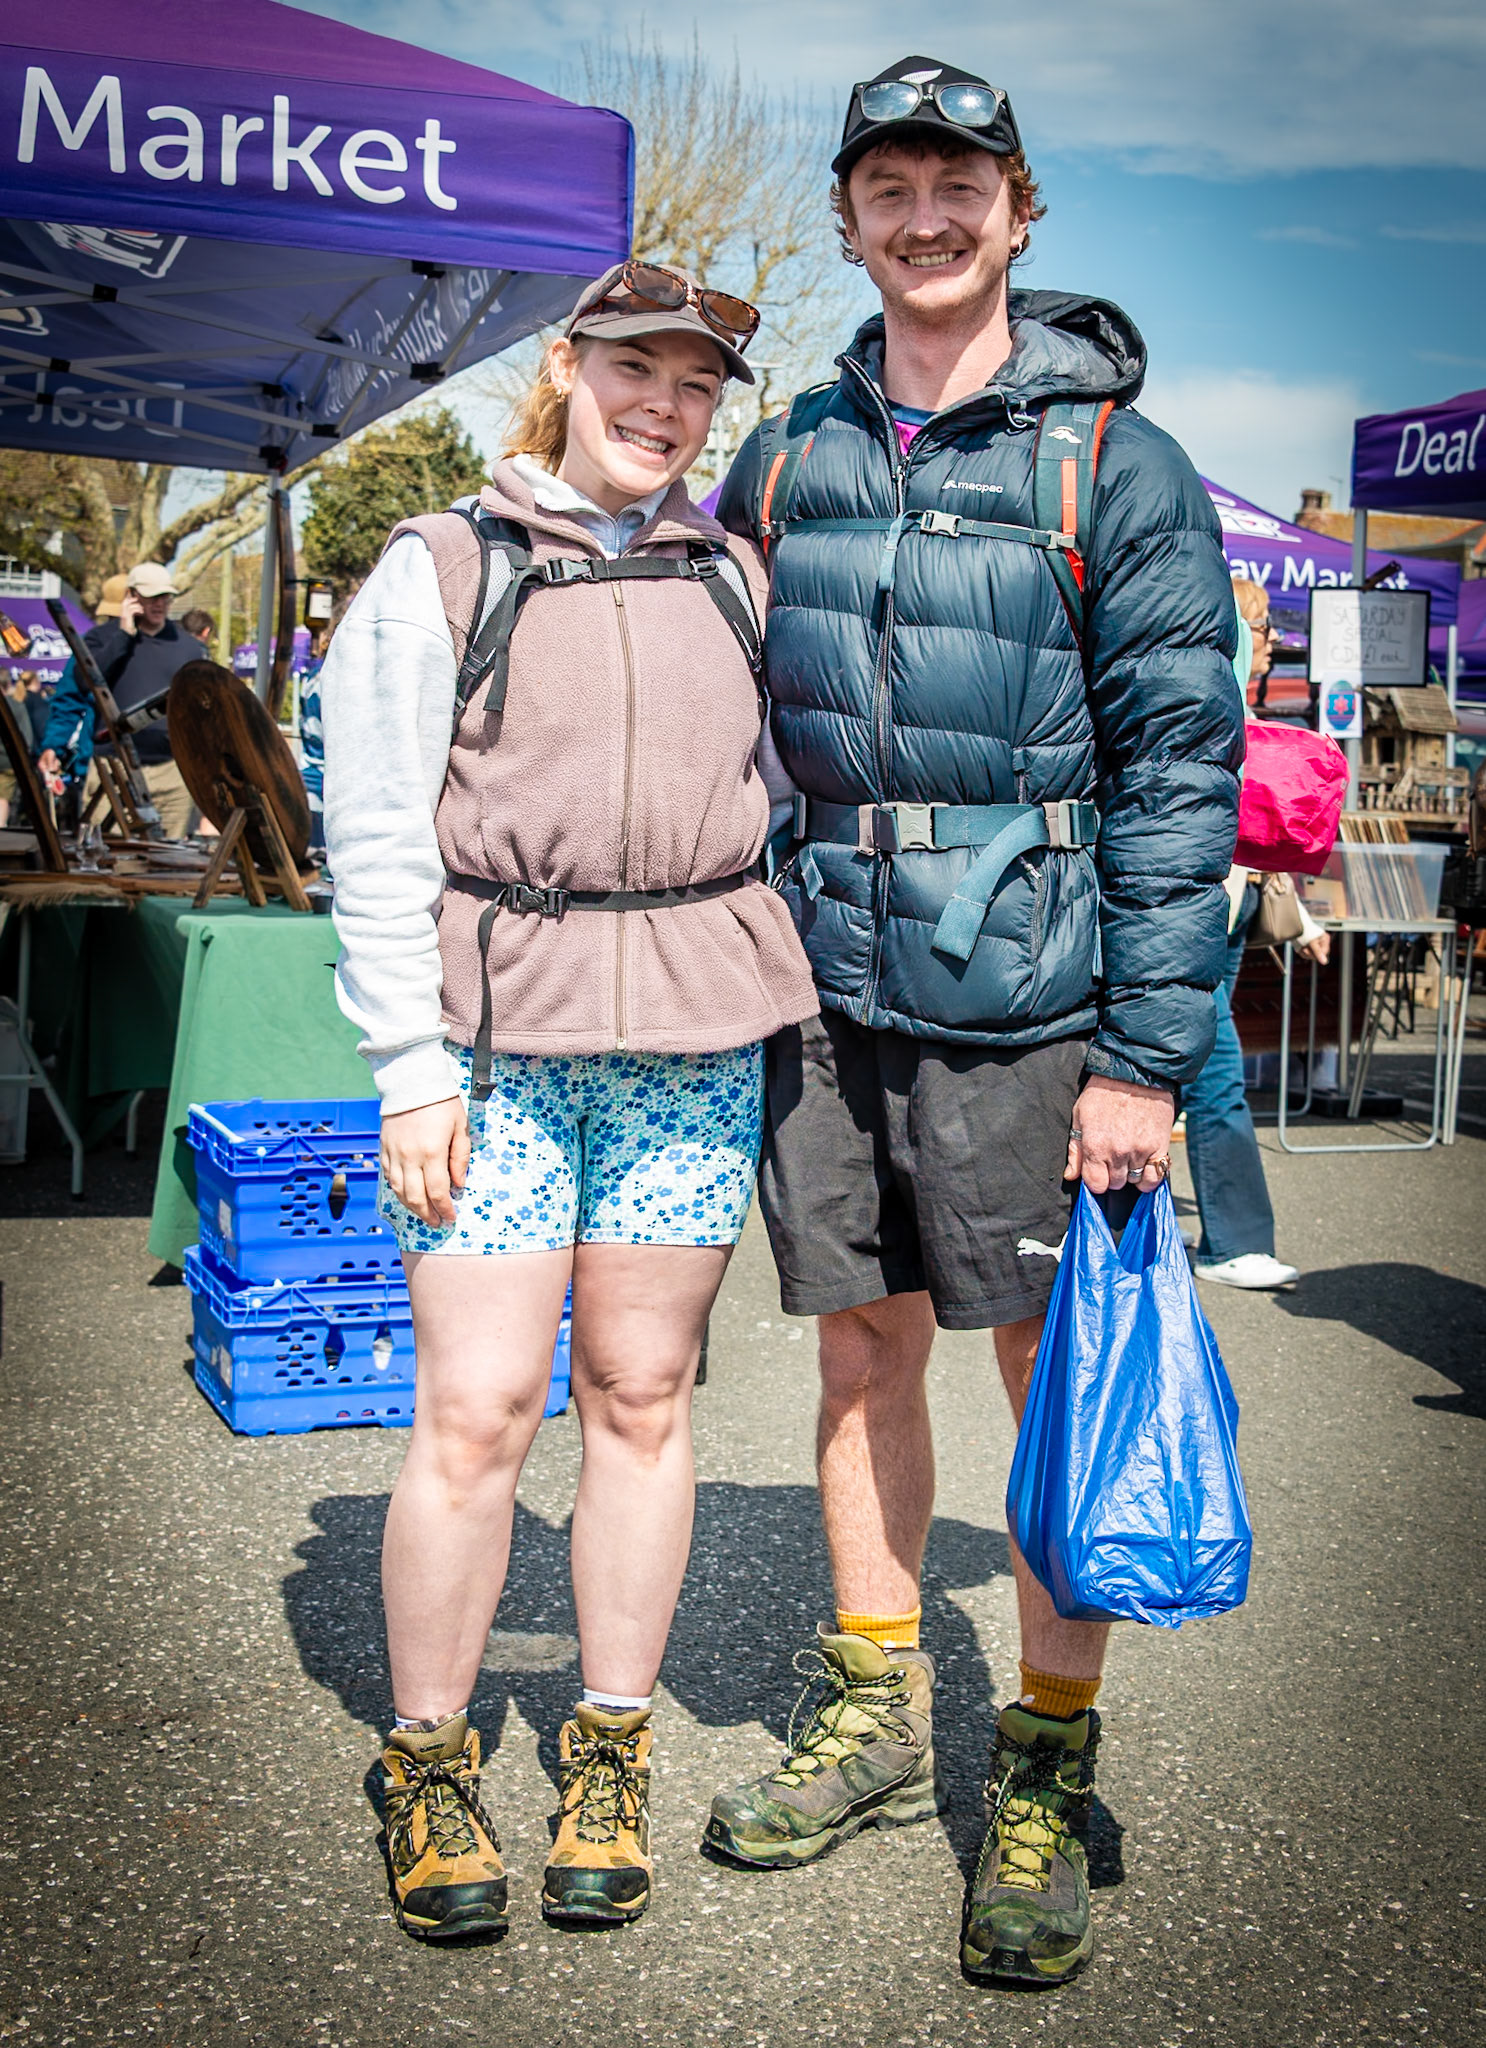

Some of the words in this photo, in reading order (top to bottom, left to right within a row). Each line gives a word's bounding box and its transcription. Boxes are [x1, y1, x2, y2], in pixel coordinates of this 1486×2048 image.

[17, 66, 458, 212] Market
[1394, 413, 1486, 477] Deal
[1332, 606, 1406, 627] SATURDAY
[1343, 627, 1402, 644] SPECIAL
